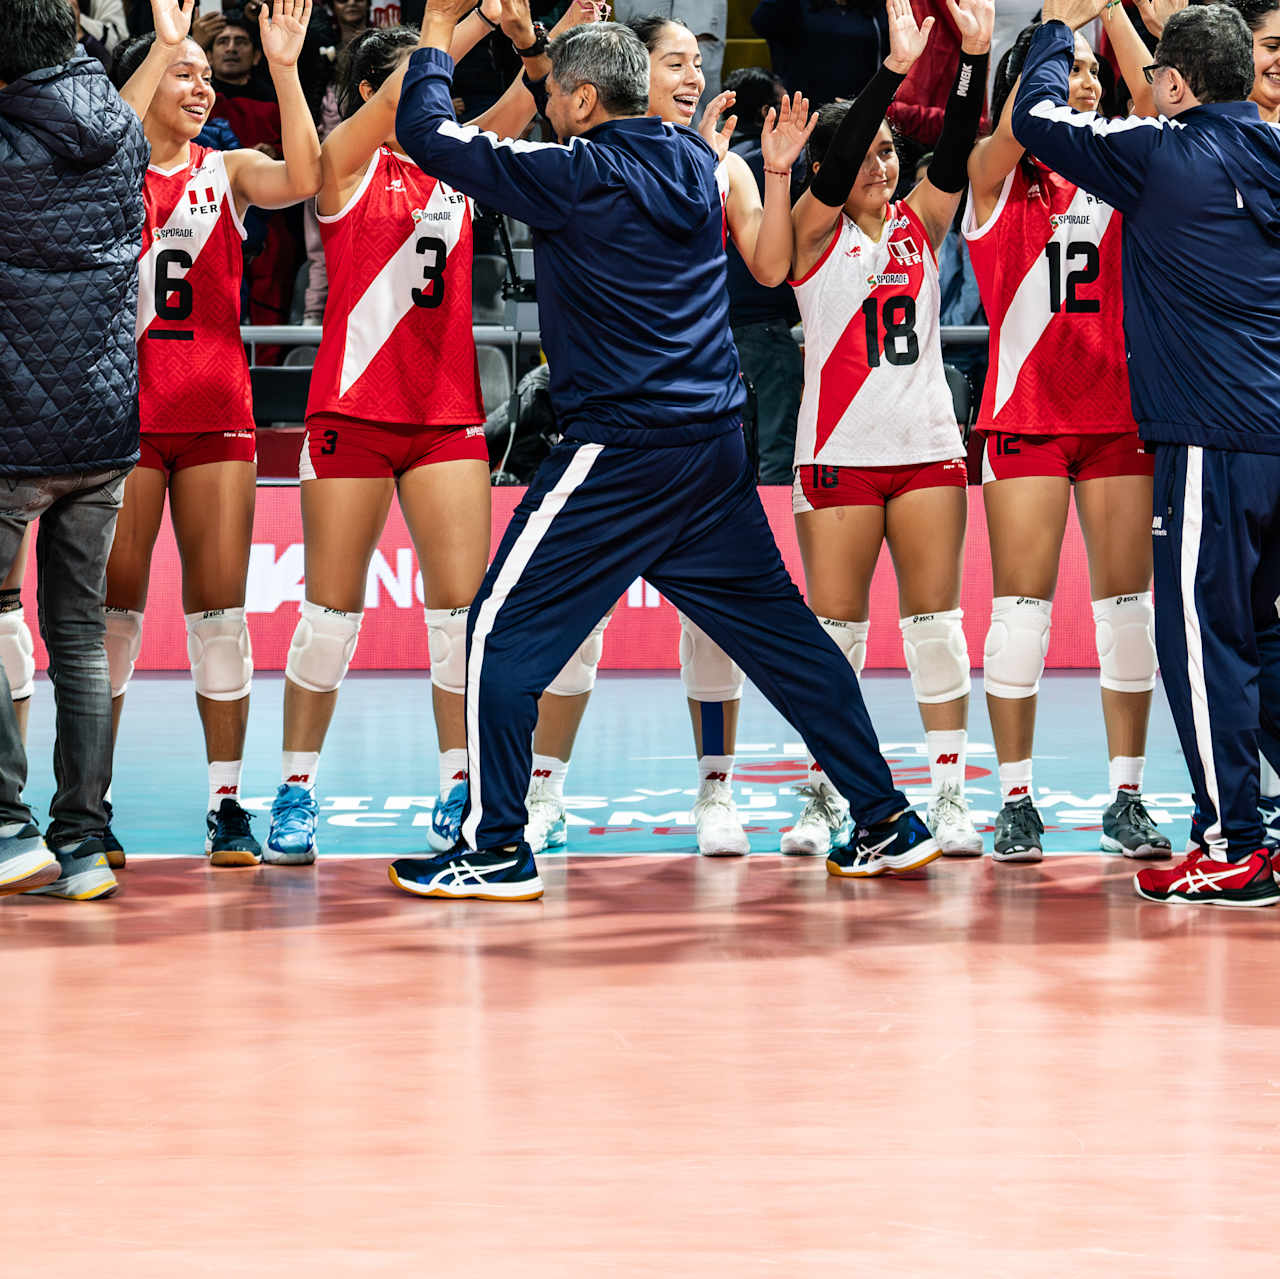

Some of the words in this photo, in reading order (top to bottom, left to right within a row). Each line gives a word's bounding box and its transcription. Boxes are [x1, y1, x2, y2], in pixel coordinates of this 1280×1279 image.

[190, 203, 219, 216] PER
[444, 193, 466, 206] ER
[1058, 214, 1091, 226] SPORADE
[160, 228, 194, 240] SPORADE
[896, 252, 923, 268] PER
[410, 236, 448, 310] 3
[876, 274, 908, 286] SPORADE
[1045, 240, 1101, 314] 12
[154, 248, 194, 322] 6
[862, 295, 919, 369] 18
[320, 429, 339, 456] 3
[813, 464, 840, 490] 18
